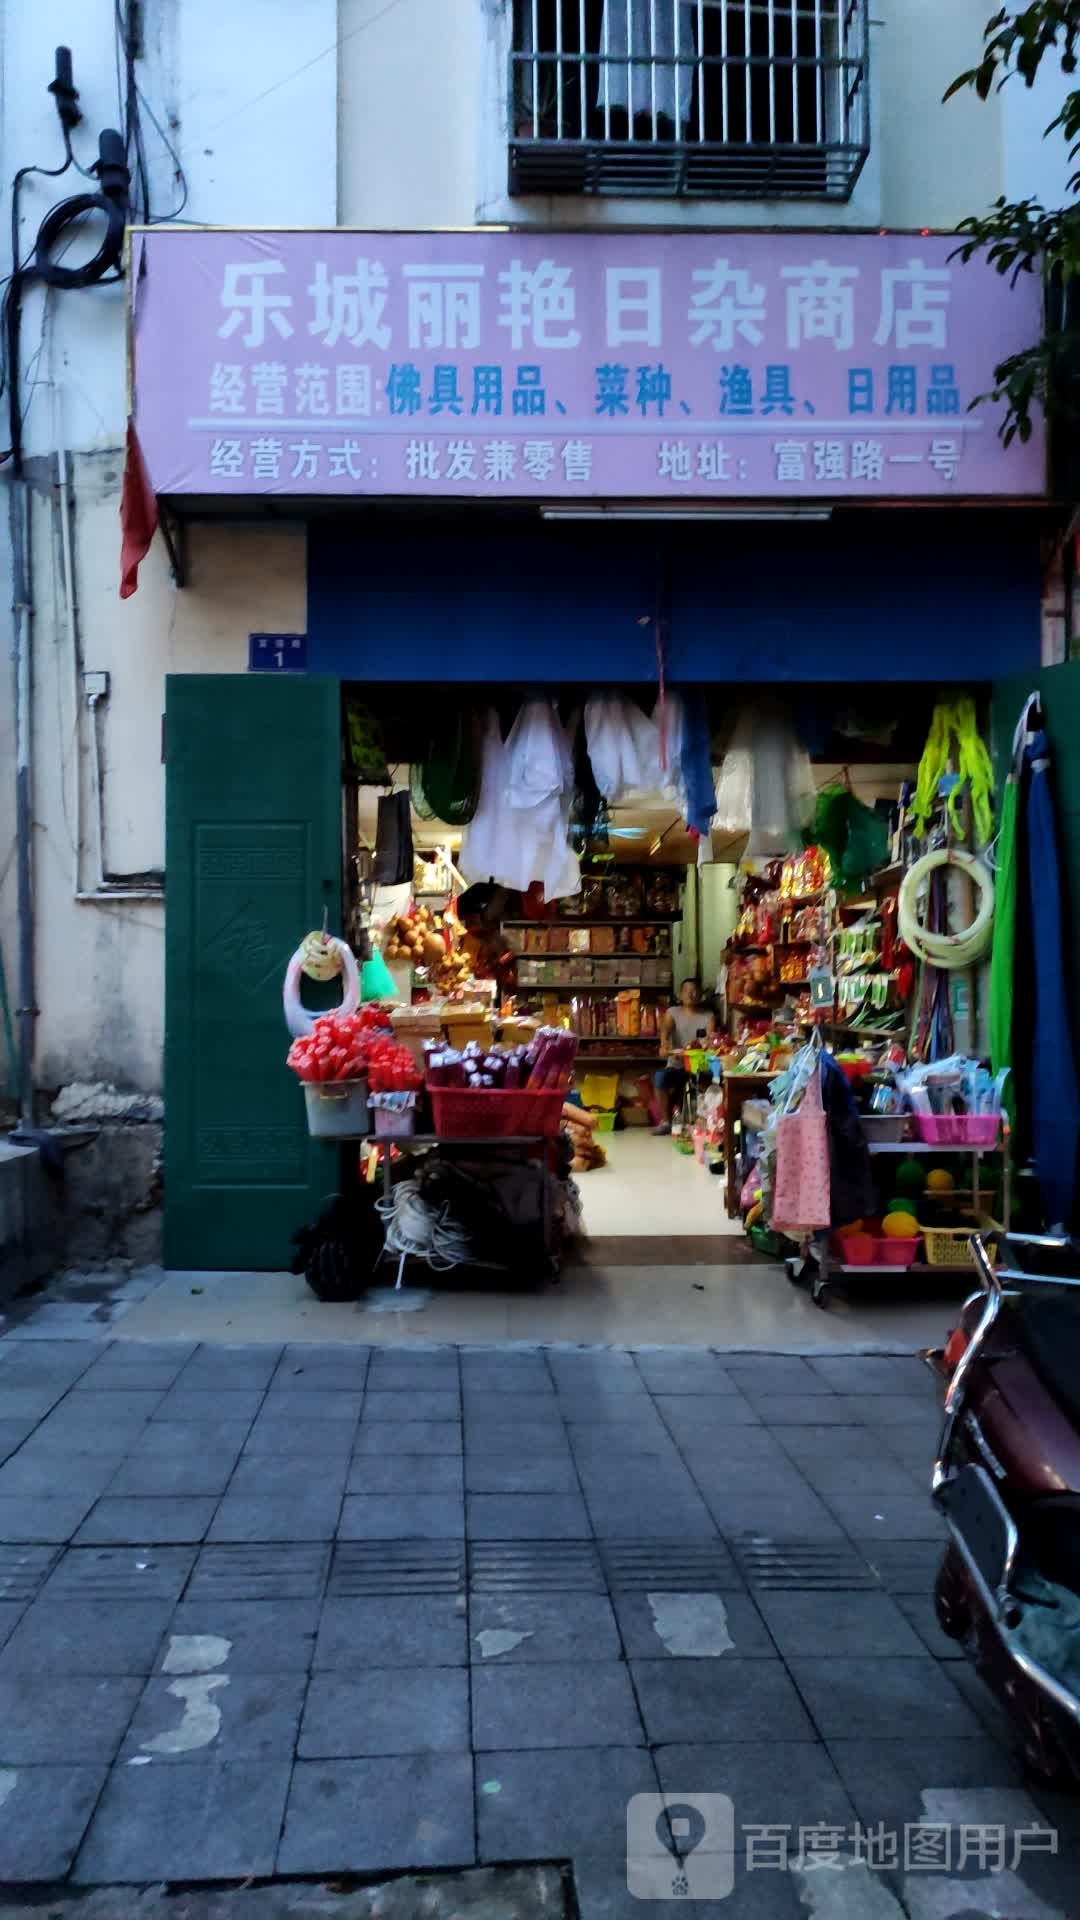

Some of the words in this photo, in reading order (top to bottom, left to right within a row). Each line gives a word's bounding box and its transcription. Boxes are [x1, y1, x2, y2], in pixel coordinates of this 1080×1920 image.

[217, 257, 953, 350] 乐城丽艳日杂商店
[274, 651, 284, 667] 1
